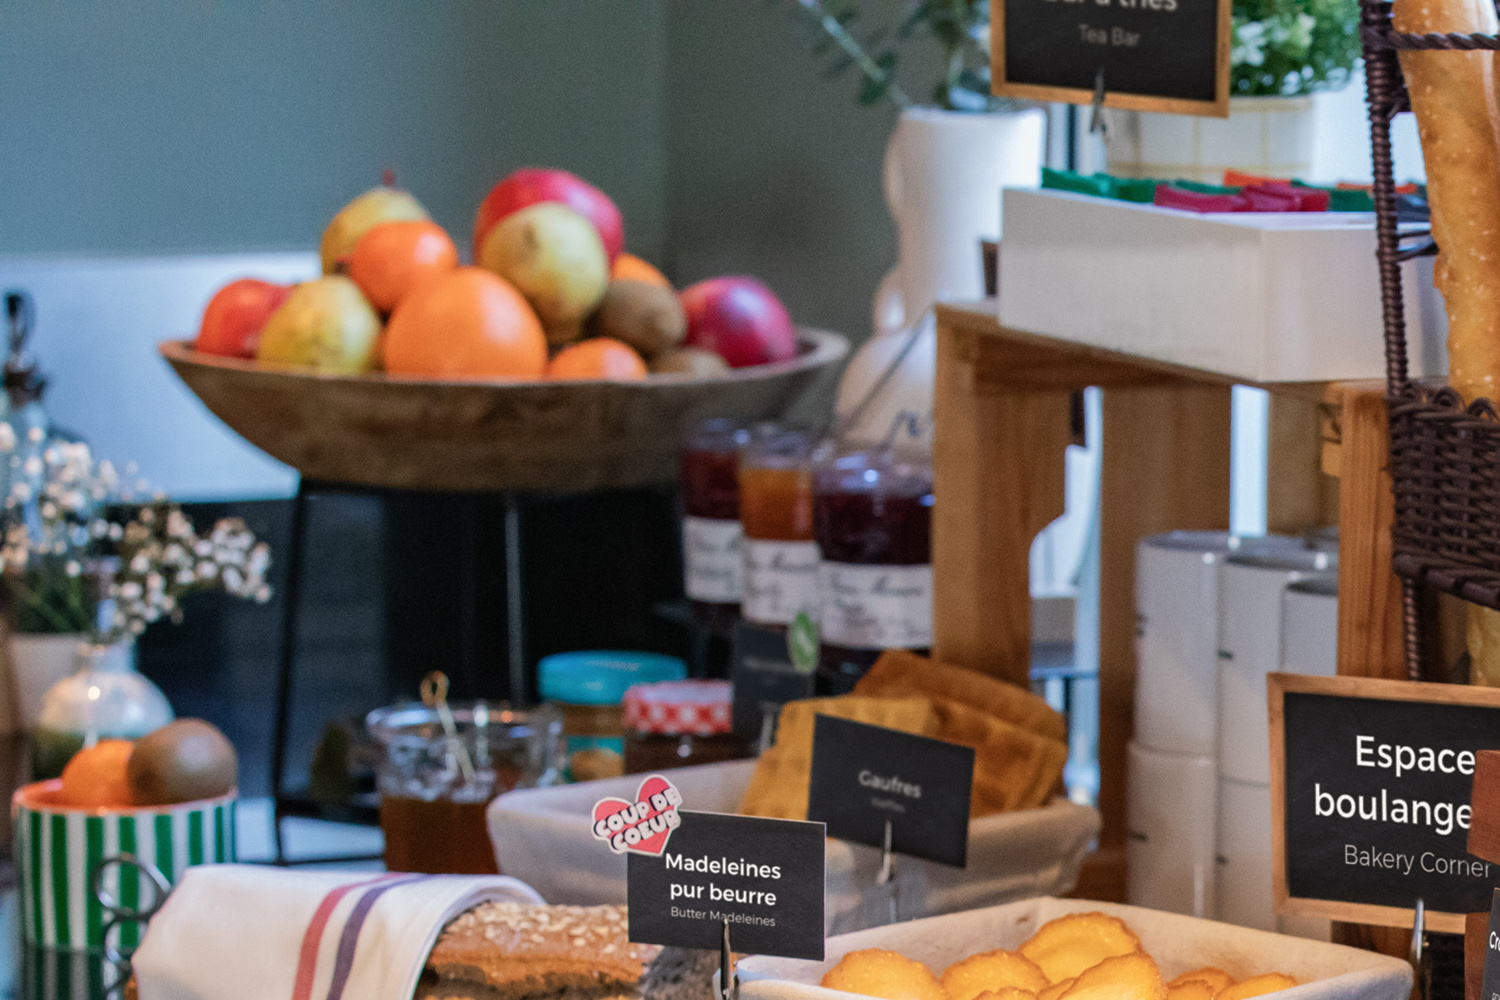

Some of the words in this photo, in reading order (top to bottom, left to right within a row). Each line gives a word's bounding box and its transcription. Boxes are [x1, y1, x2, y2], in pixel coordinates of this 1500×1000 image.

[1079, 23, 1107, 45] Tea
[1111, 26, 1140, 47] Bar
[1355, 734, 1475, 777] Espace
[858, 770, 922, 798] Gaufres
[593, 801, 650, 837] COUP
[648, 787, 681, 812] DE
[1314, 783, 1473, 835] boulange
[611, 810, 681, 851] COEUR
[665, 853, 782, 879] Madeleines
[1344, 844, 1415, 875] Bakery
[1420, 851, 1492, 878] Corner
[670, 883, 704, 900] pur
[709, 883, 777, 906] beurre
[670, 907, 707, 920] Butter
[709, 911, 776, 927] Madeleines
